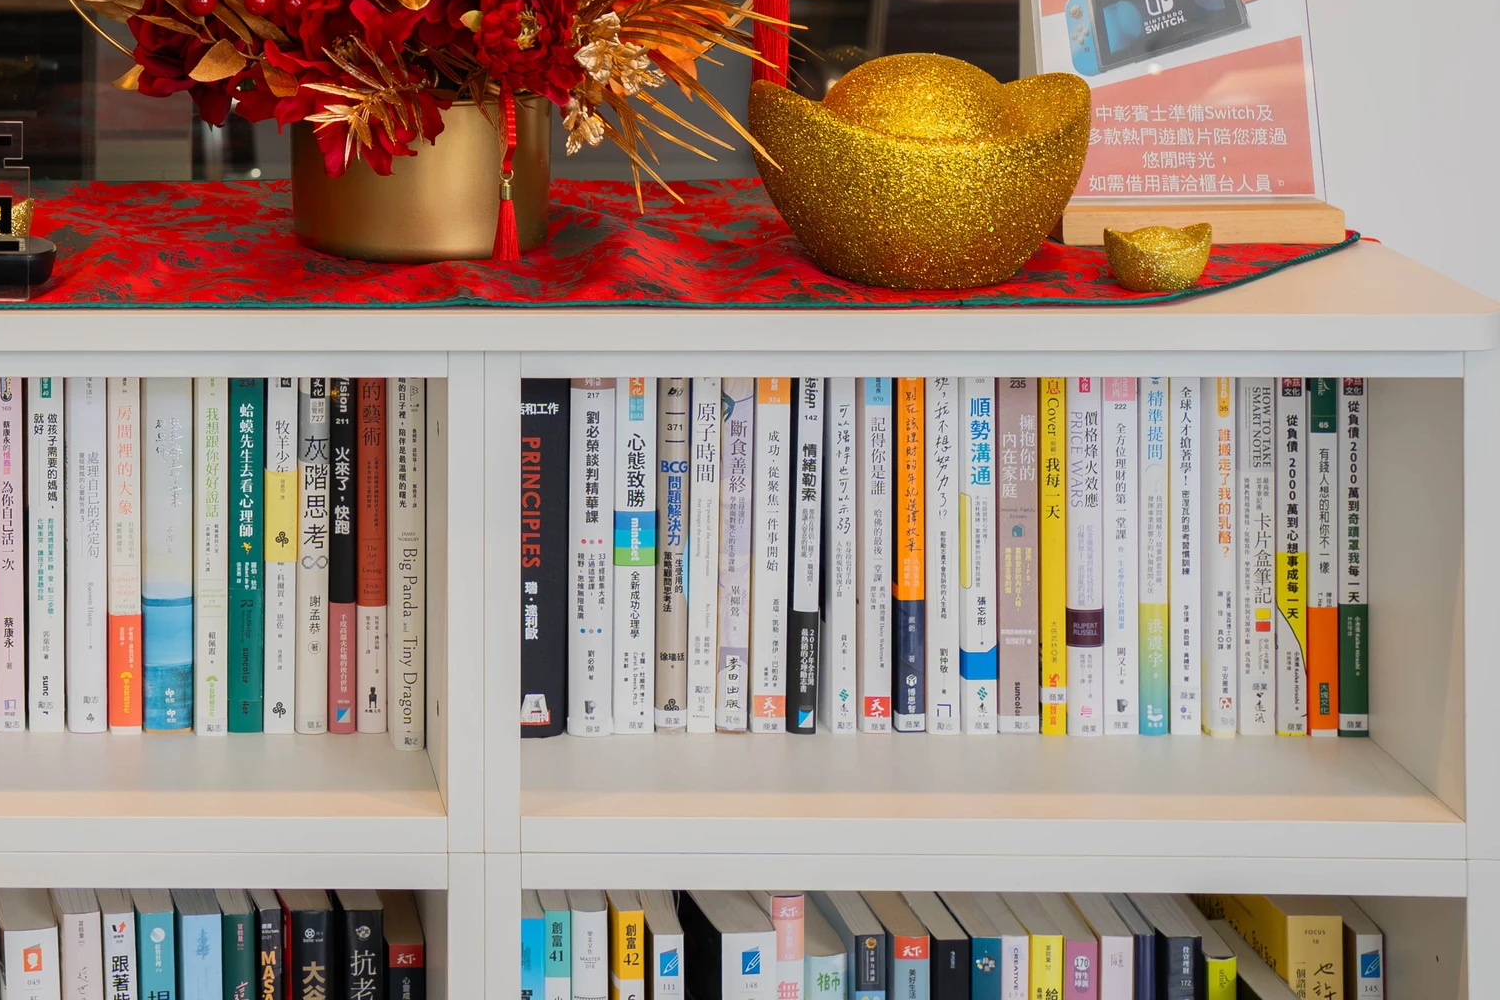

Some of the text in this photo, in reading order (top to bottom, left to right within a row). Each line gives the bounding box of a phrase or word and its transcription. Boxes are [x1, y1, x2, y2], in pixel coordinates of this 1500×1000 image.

[1088, 127, 1288, 146] 多款熱門遊戲片陪您渡過
[1095, 104, 1273, 123] 中彰賓士準備Switch及
[1088, 174, 1285, 193] 如需借用請洽櫃台人員。
[1142, 151, 1227, 169] 悠閒時光，
[362, 382, 381, 447] 的藝術
[1009, 380, 1026, 389] 235
[1047, 397, 1060, 436] Cover
[3, 420, 11, 475] 蔡康永的情商課
[33, 413, 44, 435] 就好
[667, 423, 683, 431] 371
[696, 402, 716, 484] 原子時間
[728, 419, 748, 494] 斷食善終
[870, 417, 886, 495] 記得你是誰
[970, 397, 991, 486] 順勢溝通
[1019, 414, 1036, 481] 擁抱你的
[1147, 390, 1164, 460] 精準提問
[1180, 386, 1192, 486] 全球人才搶著學！
[1253, 387, 1262, 468] SMART NOTES
[1262, 387, 1271, 468] HOW TO TAKE
[47, 413, 58, 509] 做孩子需要的媽媽，
[116, 405, 133, 515] 房間裡的大象
[205, 407, 219, 518] 我想跟你好好說話
[239, 403, 254, 537] 蛤蟆先生去看心理師
[334, 447, 350, 535] 火來了，快跑
[585, 411, 600, 524] 劉必榮談判精華課
[626, 433, 646, 508] 心態致勝
[660, 460, 688, 474] BCG
[801, 443, 818, 502] 情緒勒索
[1001, 432, 1018, 499] 內在家庭
[1045, 457, 1061, 520] 我每一天
[1071, 411, 1083, 508] PRICE WARS
[1084, 411, 1099, 508] 價格烽火效應
[1115, 423, 1127, 540] 全方位理財的第一堂課
[87, 451, 100, 559] 處理自己的否定句
[303, 436, 329, 549] 灰階思考
[522, 437, 541, 567] PRINCIPLES
[667, 476, 682, 547] 問題解決力
[1218, 429, 1231, 558] 誰搬走了我的乳酪？
[1286, 414, 1299, 619] 從負債2000萬到心想事成每一天
[1319, 448, 1330, 574] 有錢人想的和你不一樣
[1347, 400, 1360, 603] 從負債2000萬到奇蹟罩我每一天
[1, 481, 15, 571] 為你自己活一次
[873, 509, 883, 582] 哈佛的最後一堂課
[1254, 512, 1271, 604] 卡片盒筆記
[576, 552, 584, 619] 視野、思維無限寬廣
[629, 571, 640, 639] 全新成功心理學
[663, 551, 672, 613] 策略顧問思考法
[674, 552, 683, 593] 一生受用的
[3, 617, 14, 648] 蔡康永
[309, 595, 320, 634] 謝孟恭
[398, 548, 418, 725] Big Panda and Tiny Dragon
[976, 596, 987, 626] 張忘形
[1073, 628, 1098, 636] RUSSELL
[800, 628, 809, 693] 最熱銷的心理勵志書
[974, 722, 990, 730] 商業
[1049, 693, 1064, 701] 商業
[1113, 721, 1129, 729] 商業
[1180, 692, 1196, 700] 商業
[1287, 723, 1303, 731] 商業
[1319, 683, 1329, 715] 大塊文化
[585, 725, 600, 733] 商業
[1081, 725, 1097, 733] 商業
[549, 950, 564, 962] 41
[551, 921, 563, 948] 創富
[623, 953, 640, 966] 42
[625, 923, 637, 950] 創富
[1075, 958, 1090, 968] 170
[1180, 979, 1192, 987] 172
[1364, 984, 1378, 993] 145
